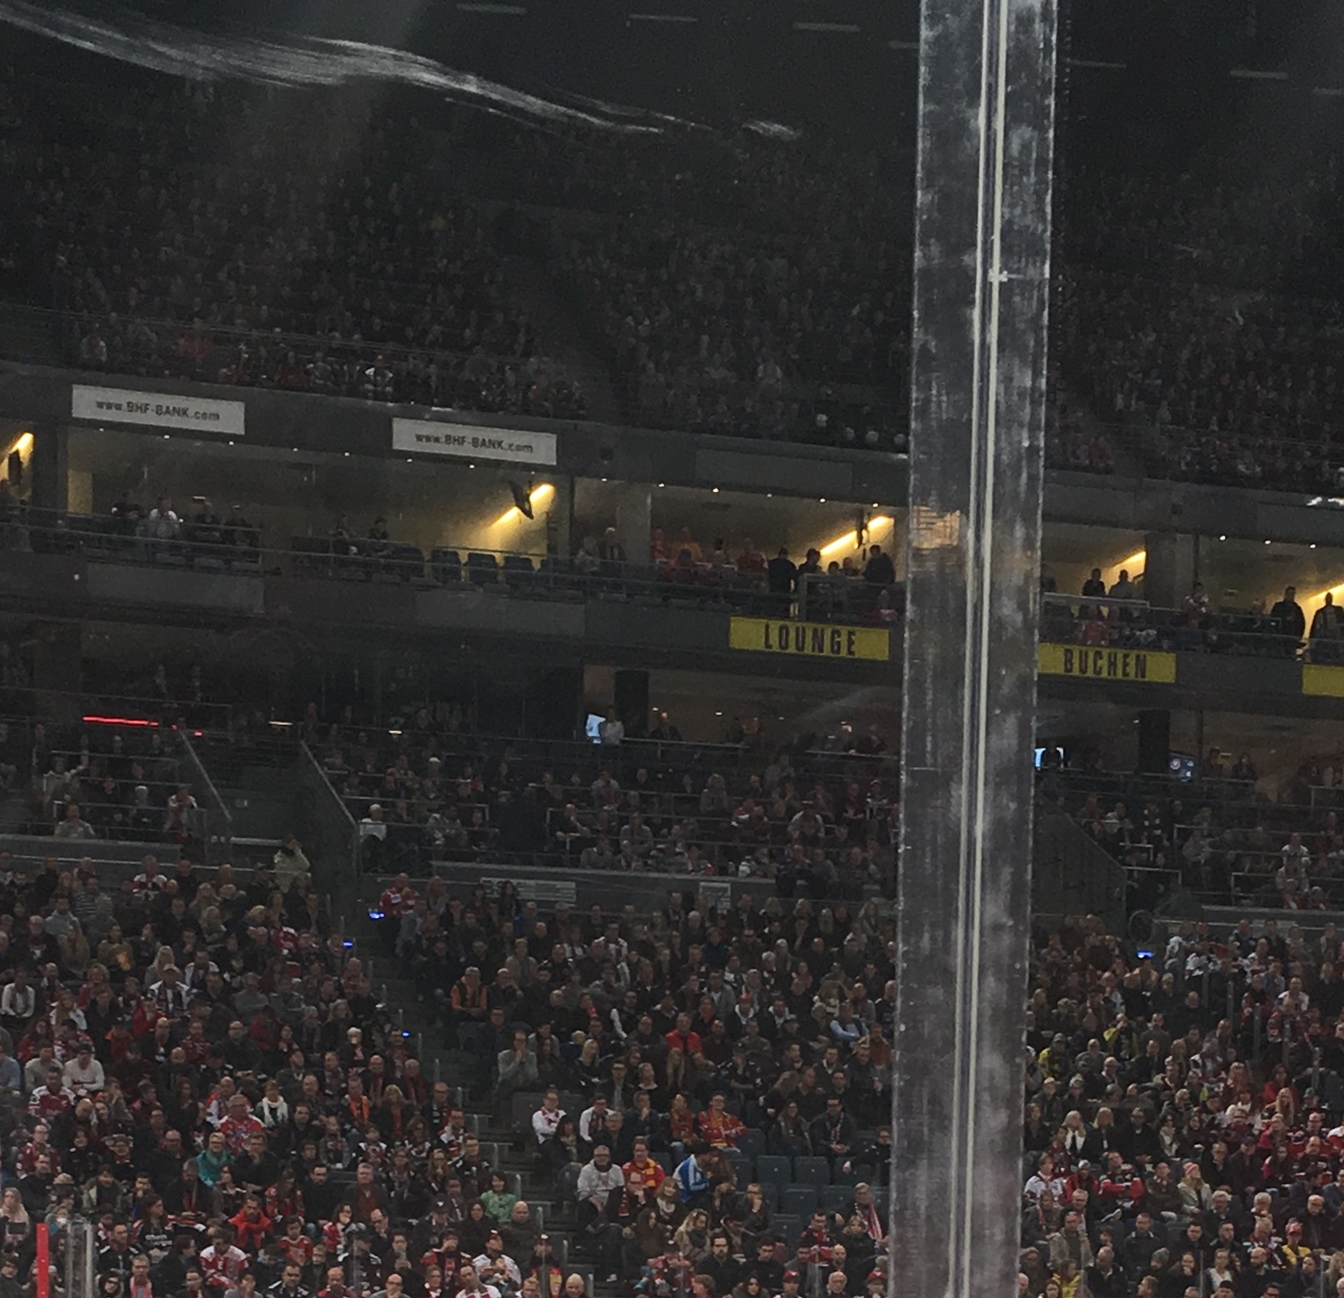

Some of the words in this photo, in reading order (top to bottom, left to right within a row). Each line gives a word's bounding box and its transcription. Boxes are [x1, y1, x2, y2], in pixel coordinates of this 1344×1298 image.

[95, 399, 220, 422] www.BHF-BANK.com
[414, 432, 534, 453] www.BHF-BANK.com
[762, 622, 857, 656] LOUNGE
[1062, 648, 1148, 680] BUCHEN
